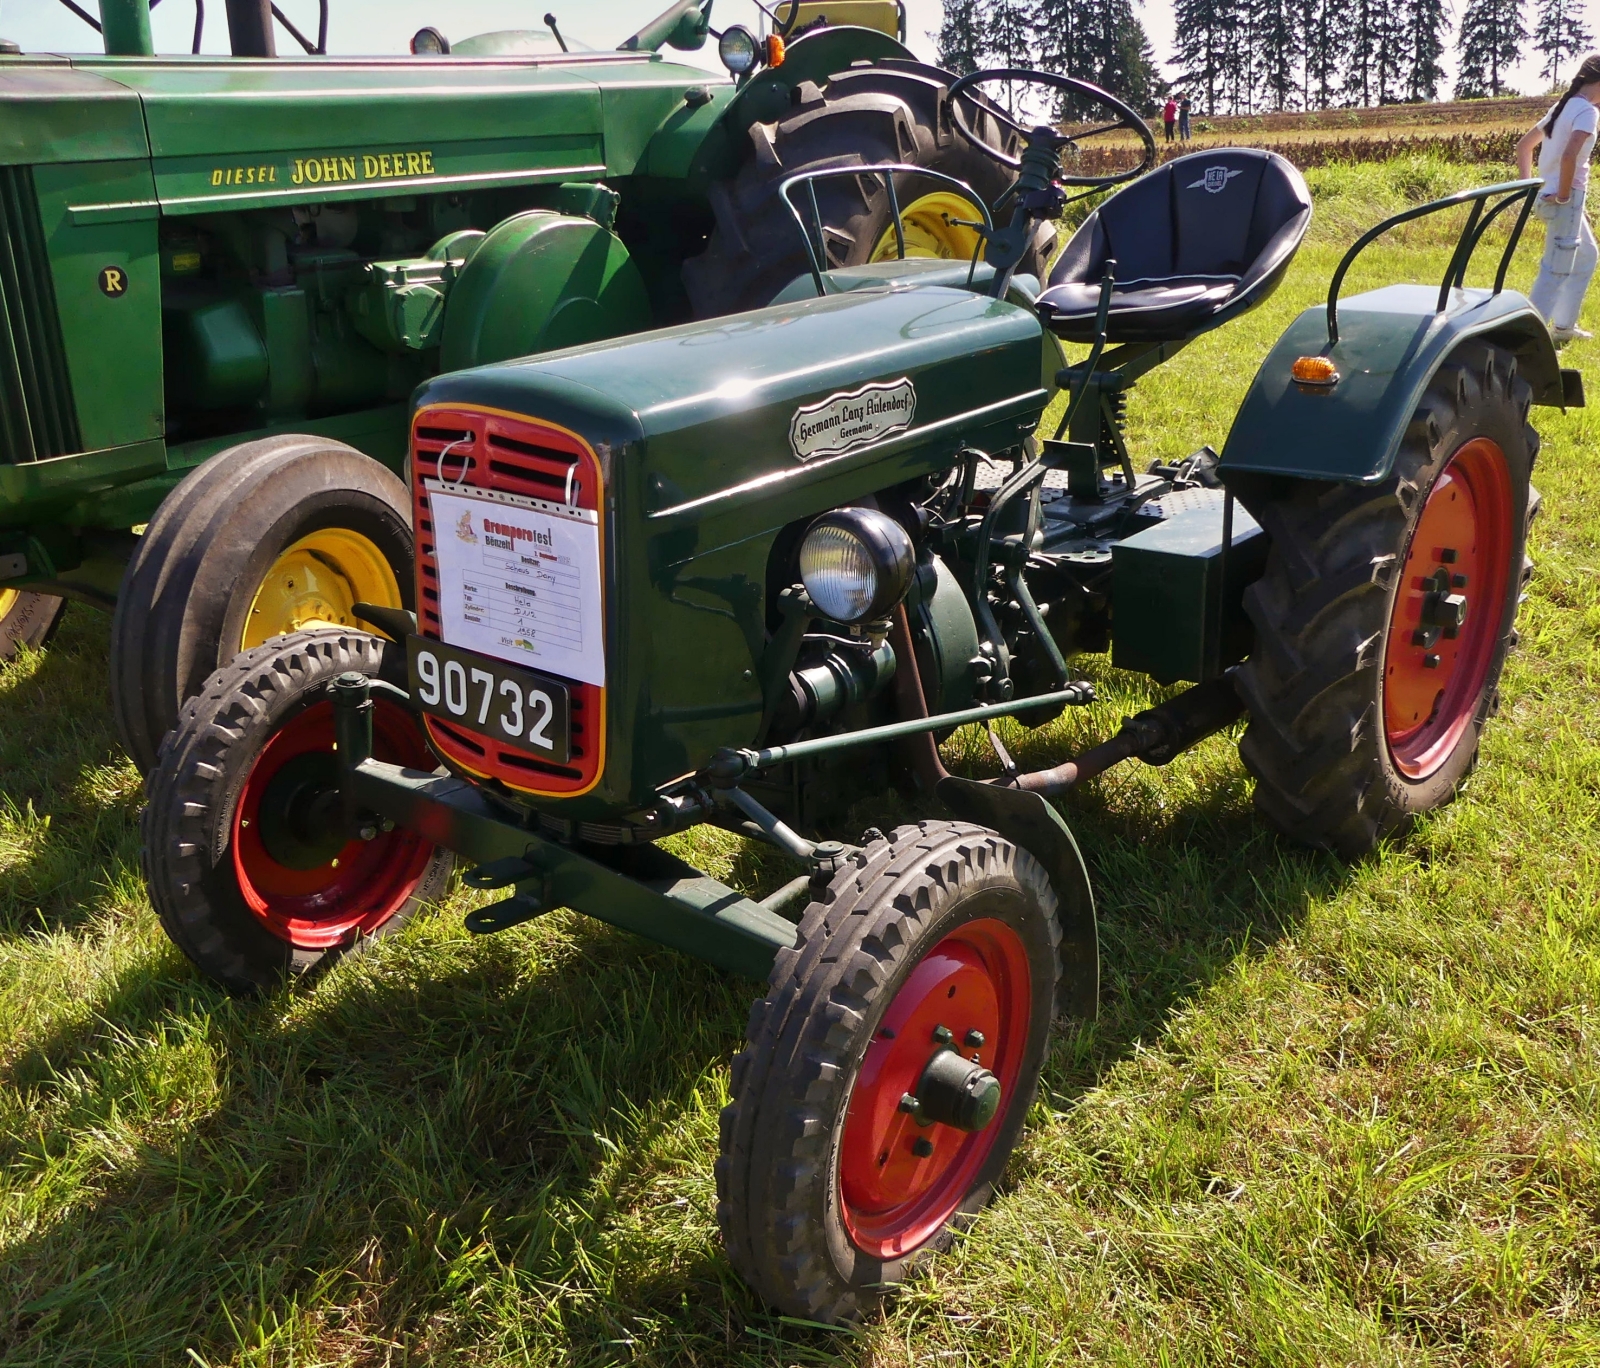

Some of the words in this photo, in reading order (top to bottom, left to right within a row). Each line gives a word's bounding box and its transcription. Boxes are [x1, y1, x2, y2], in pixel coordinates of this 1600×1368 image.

[211, 165, 276, 186] DIESEL
[291, 156, 357, 184] JOHN
[362, 151, 435, 179] DEERE
[105, 269, 122, 292] R
[800, 414, 841, 445] Hermann
[842, 405, 864, 423] Lanz
[866, 392, 909, 416] Aulendorf
[840, 421, 873, 439] Germania
[501, 636, 513, 646] Visit
[517, 627, 536, 638] 1958
[417, 650, 554, 751] 90732
